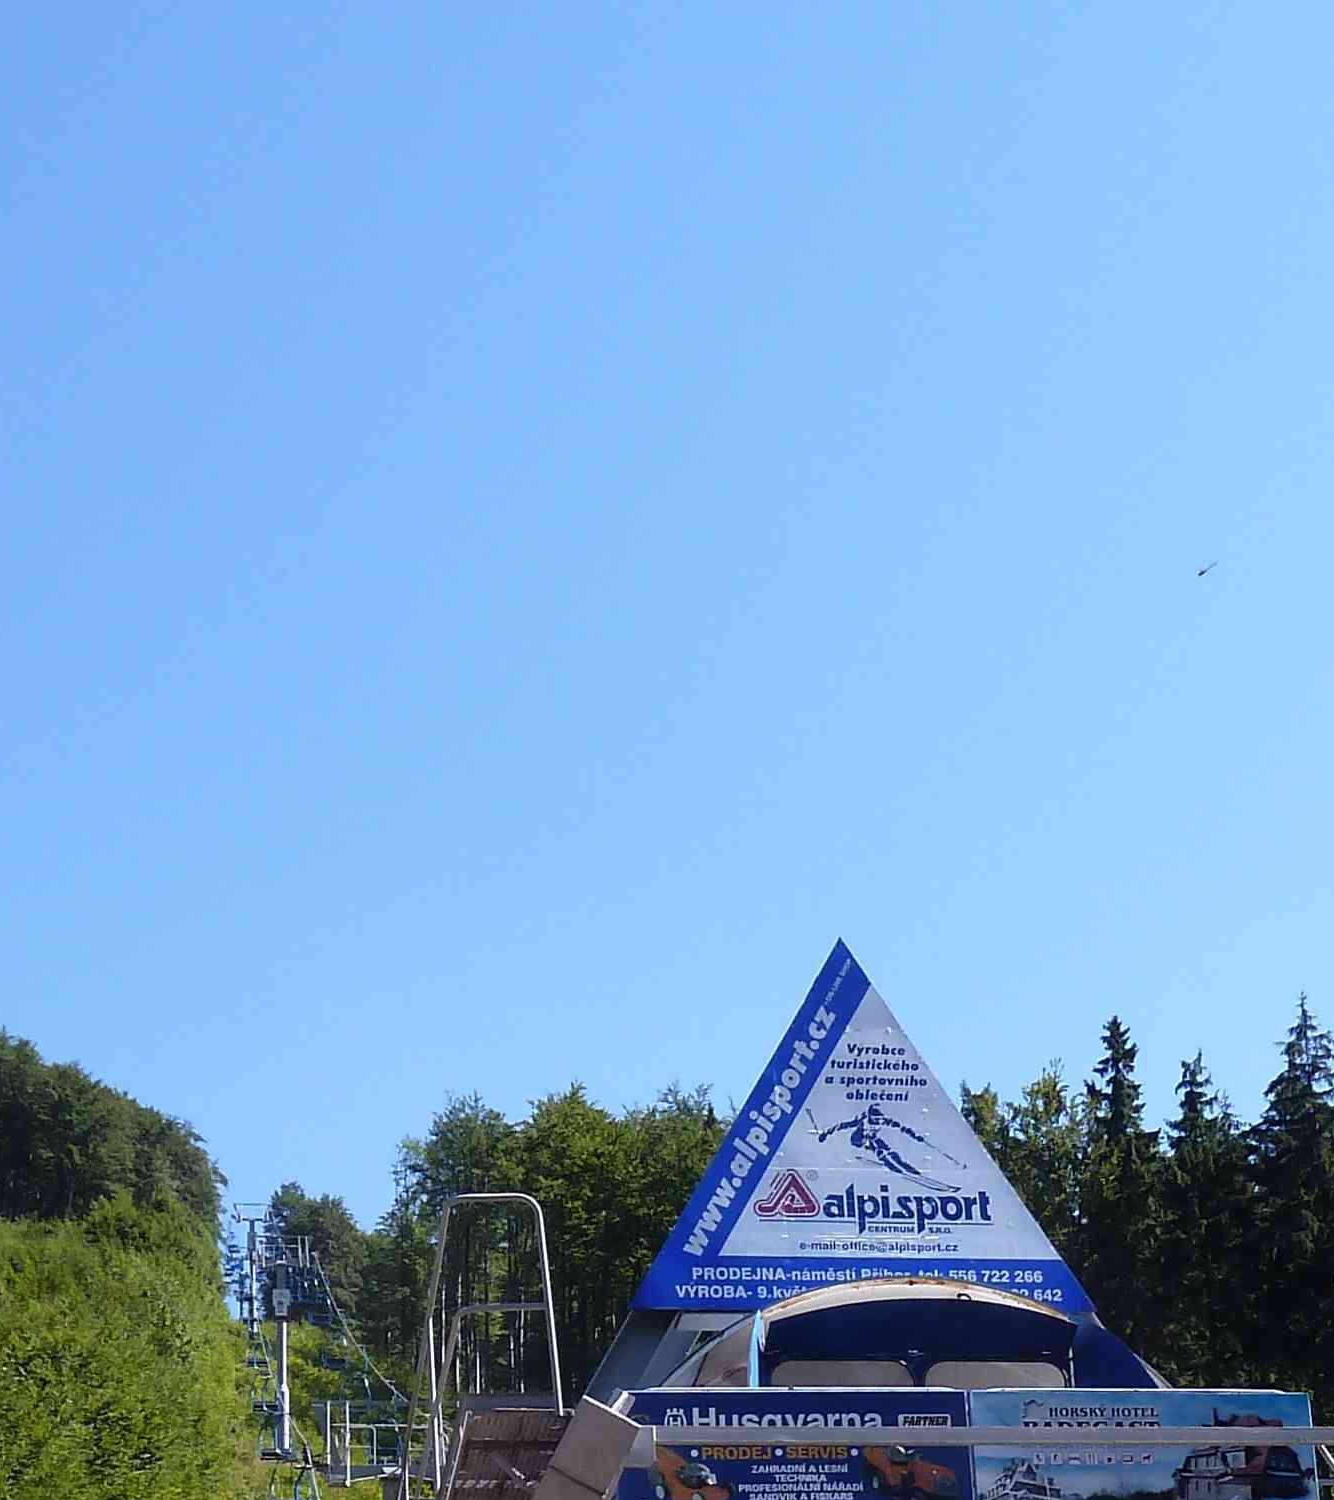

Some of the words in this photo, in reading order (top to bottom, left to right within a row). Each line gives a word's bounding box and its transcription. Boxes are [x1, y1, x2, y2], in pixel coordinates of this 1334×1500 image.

[825, 1076, 834, 1084] a
[840, 1074, 928, 1088] sportovního
[846, 1089, 909, 1101] oblečení
[682, 1005, 836, 1257] www.alpisport.cz
[822, 1183, 992, 1234] alpisport
[868, 1226, 915, 1234] CENTRUM
[948, 1269, 976, 1283] 556
[981, 1270, 1010, 1283] 722
[1014, 1270, 1043, 1284] 266
[1034, 1289, 1063, 1302] 642
[1111, 1406, 1159, 1418] HOTEL
[701, 1446, 772, 1461] PRODEJ
[786, 1445, 848, 1460] SERVIS
